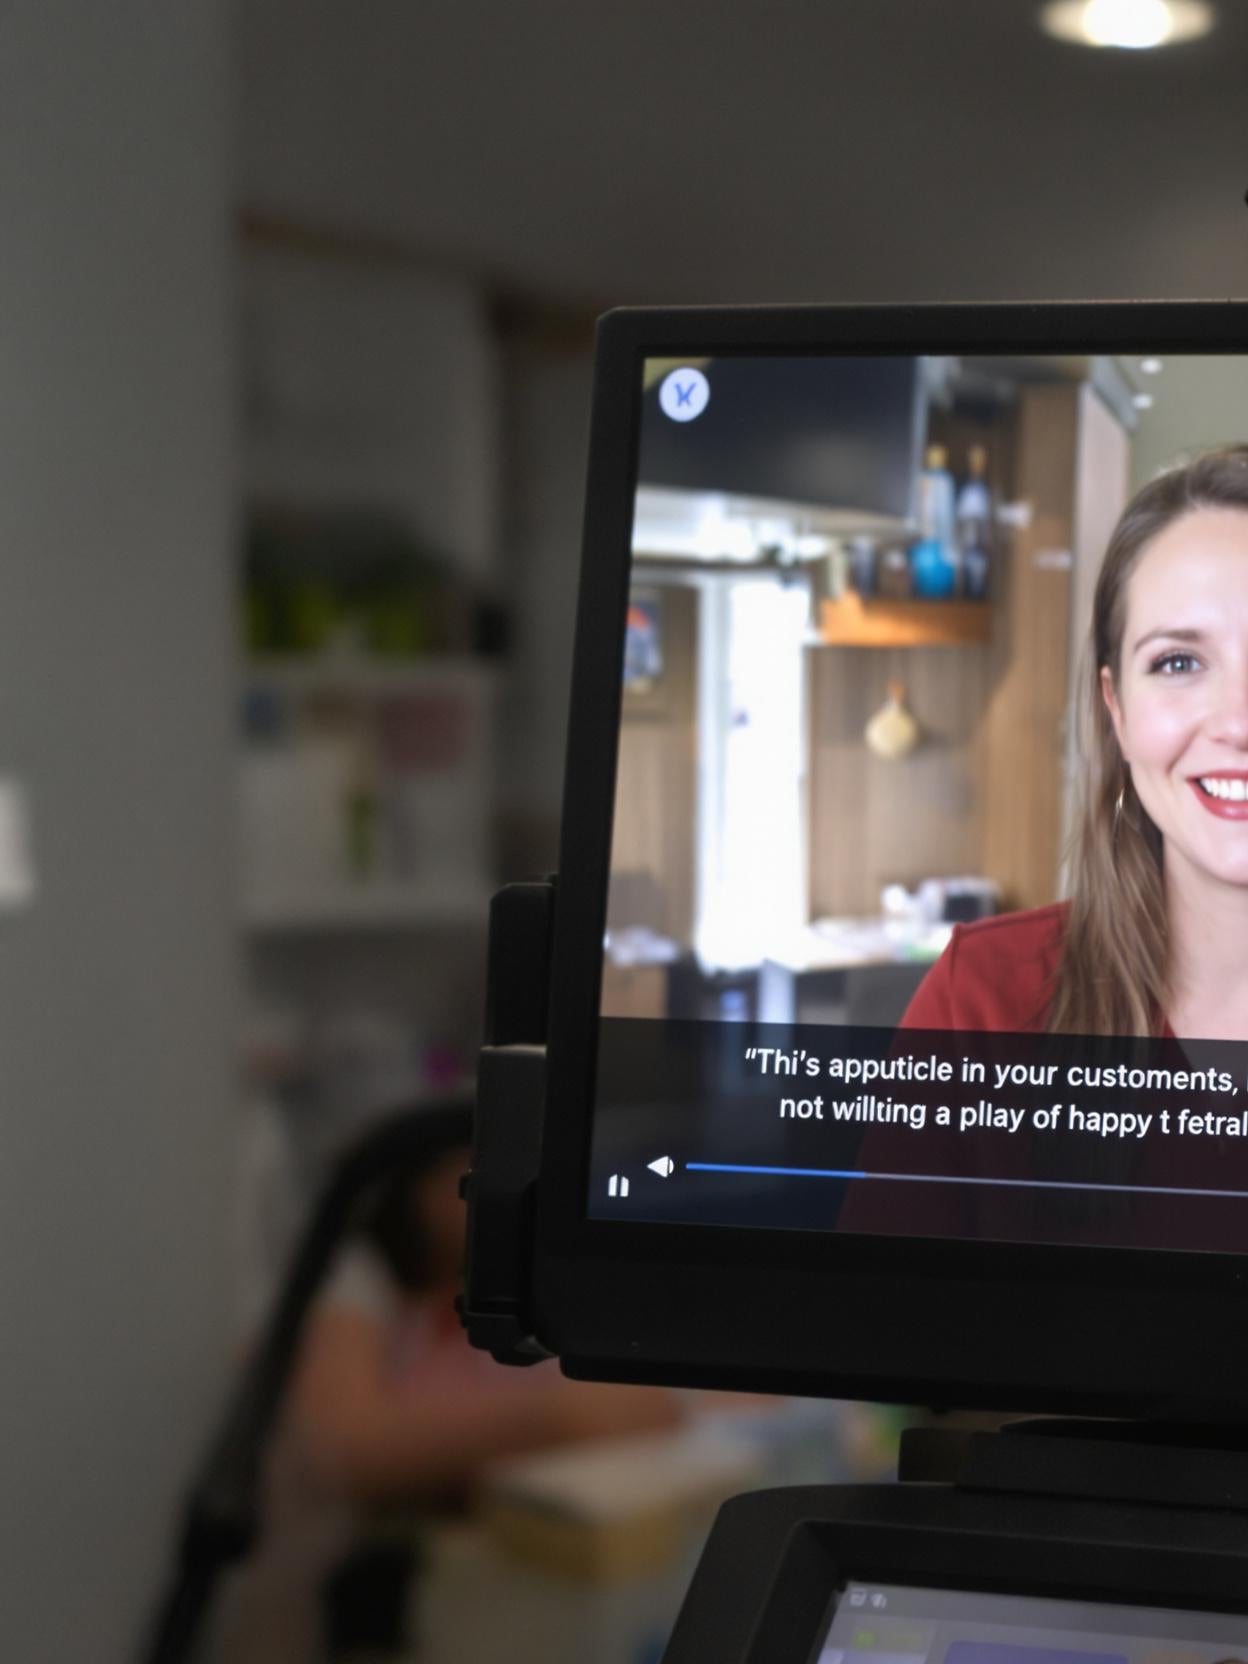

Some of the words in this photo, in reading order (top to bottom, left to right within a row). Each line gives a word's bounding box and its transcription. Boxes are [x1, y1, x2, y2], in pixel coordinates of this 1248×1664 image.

[828, 1055, 953, 1084] apputicle
[961, 1057, 986, 1083] in
[993, 1064, 1059, 1089] your
[1067, 1064, 1239, 1097] customents,
[779, 1095, 824, 1120] not
[935, 1105, 951, 1126] a
[959, 1100, 1026, 1133] pllay
[1032, 1103, 1063, 1130] of
[1068, 1103, 1153, 1139] happy
